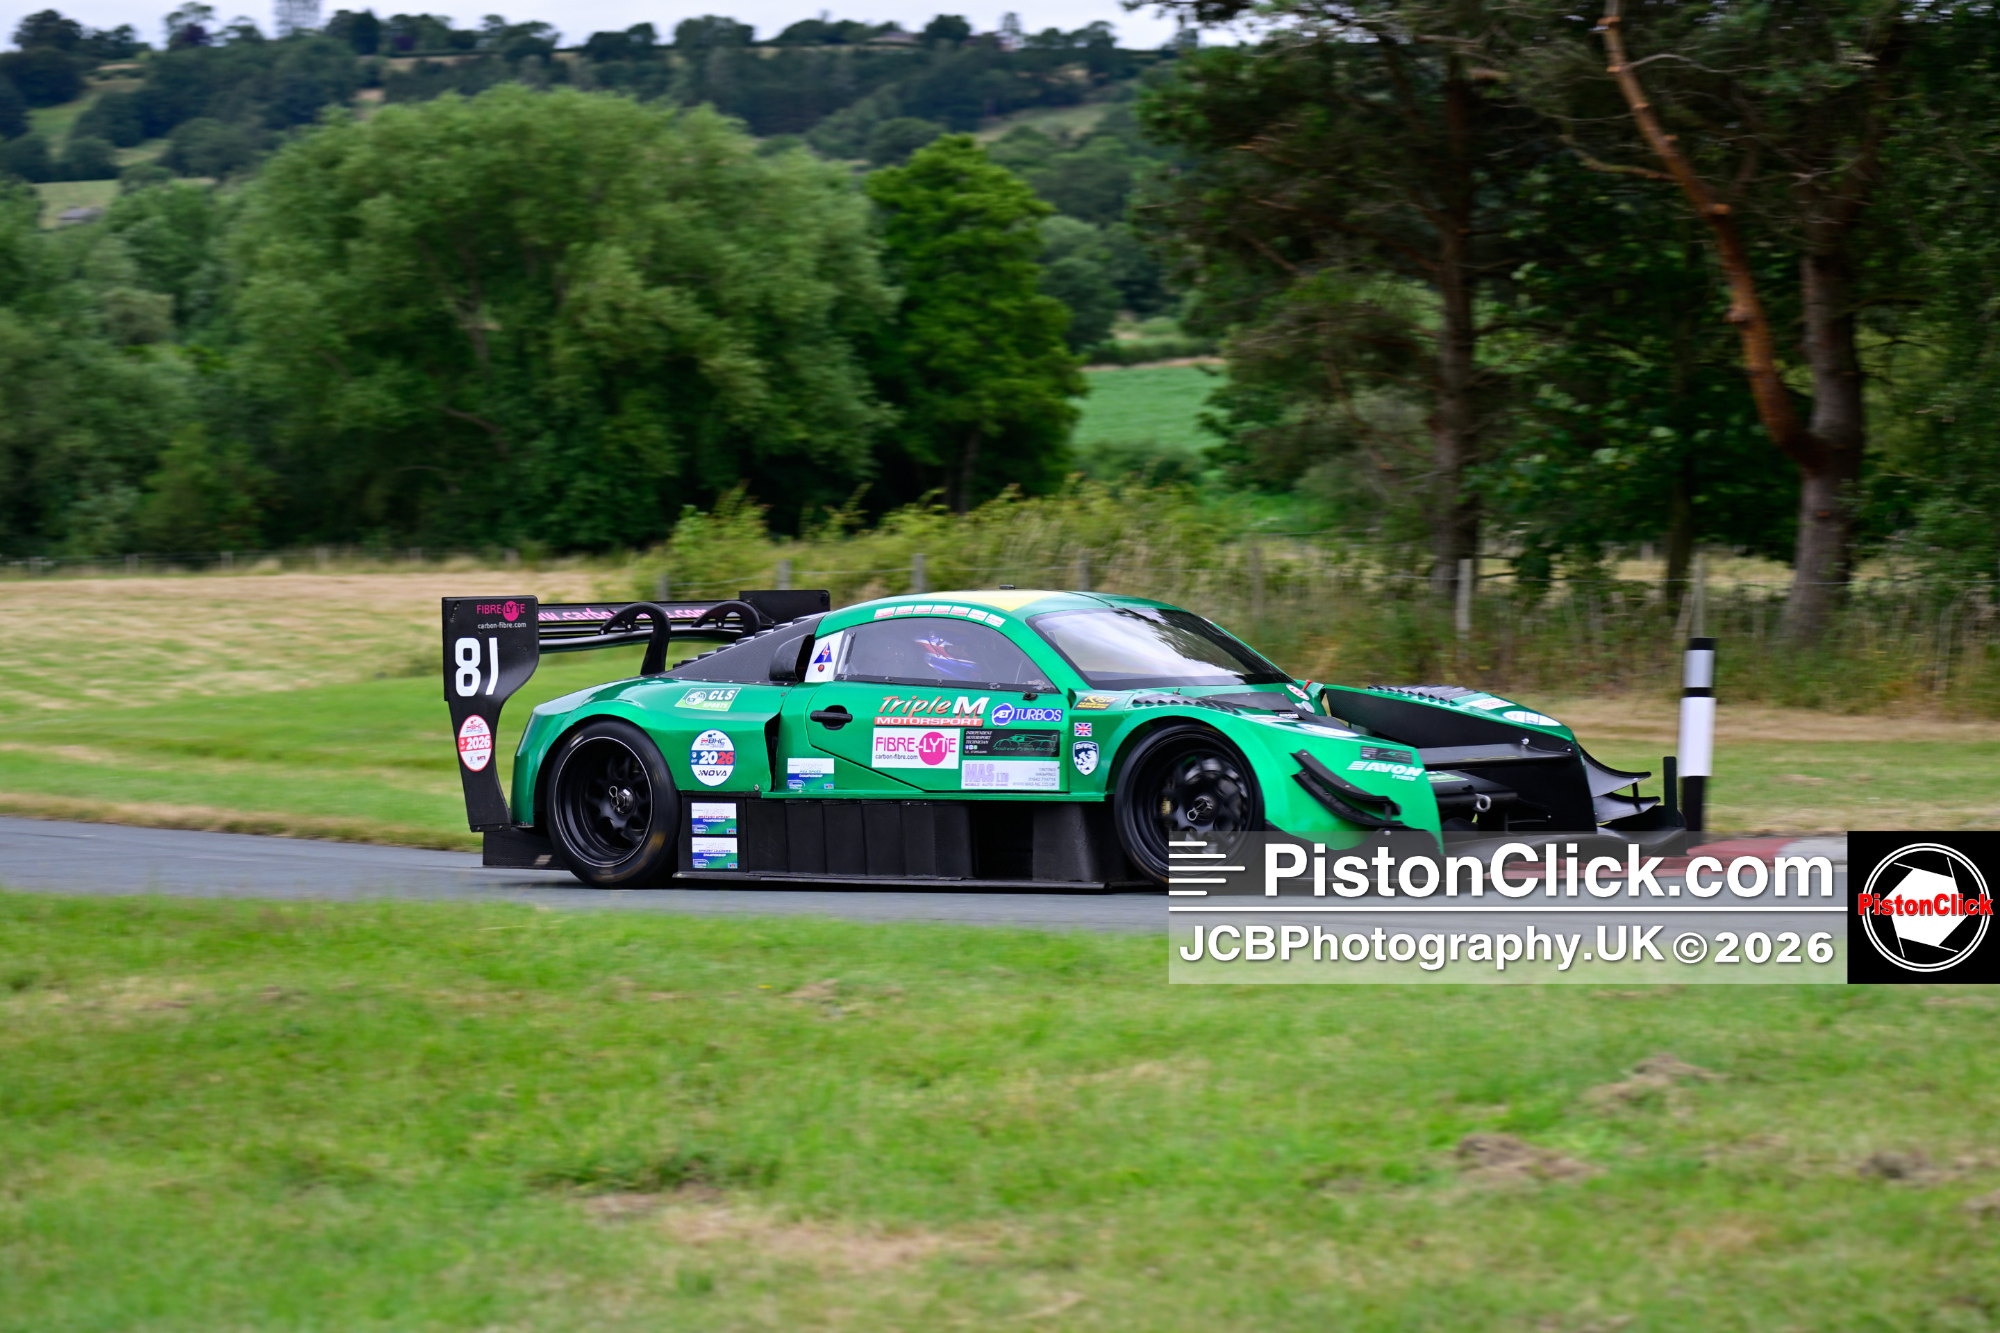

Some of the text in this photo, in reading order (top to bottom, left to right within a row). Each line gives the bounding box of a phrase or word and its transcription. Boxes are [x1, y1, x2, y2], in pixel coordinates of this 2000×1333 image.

[476, 603, 526, 615] FIBRE-LYTE
[477, 621, 527, 630] carbon-fibre.com
[455, 637, 499, 697] 81
[708, 690, 736, 701] CLS
[878, 695, 952, 718] Triple
[876, 716, 982, 727] MOTORSPORT
[1015, 708, 1063, 722] TURBOS
[466, 735, 491, 750] 2026
[875, 736, 957, 753] FIBRE-LYTE
[698, 751, 735, 765] 2026
[965, 763, 995, 783] MAS
[1363, 762, 1425, 777] AVON
